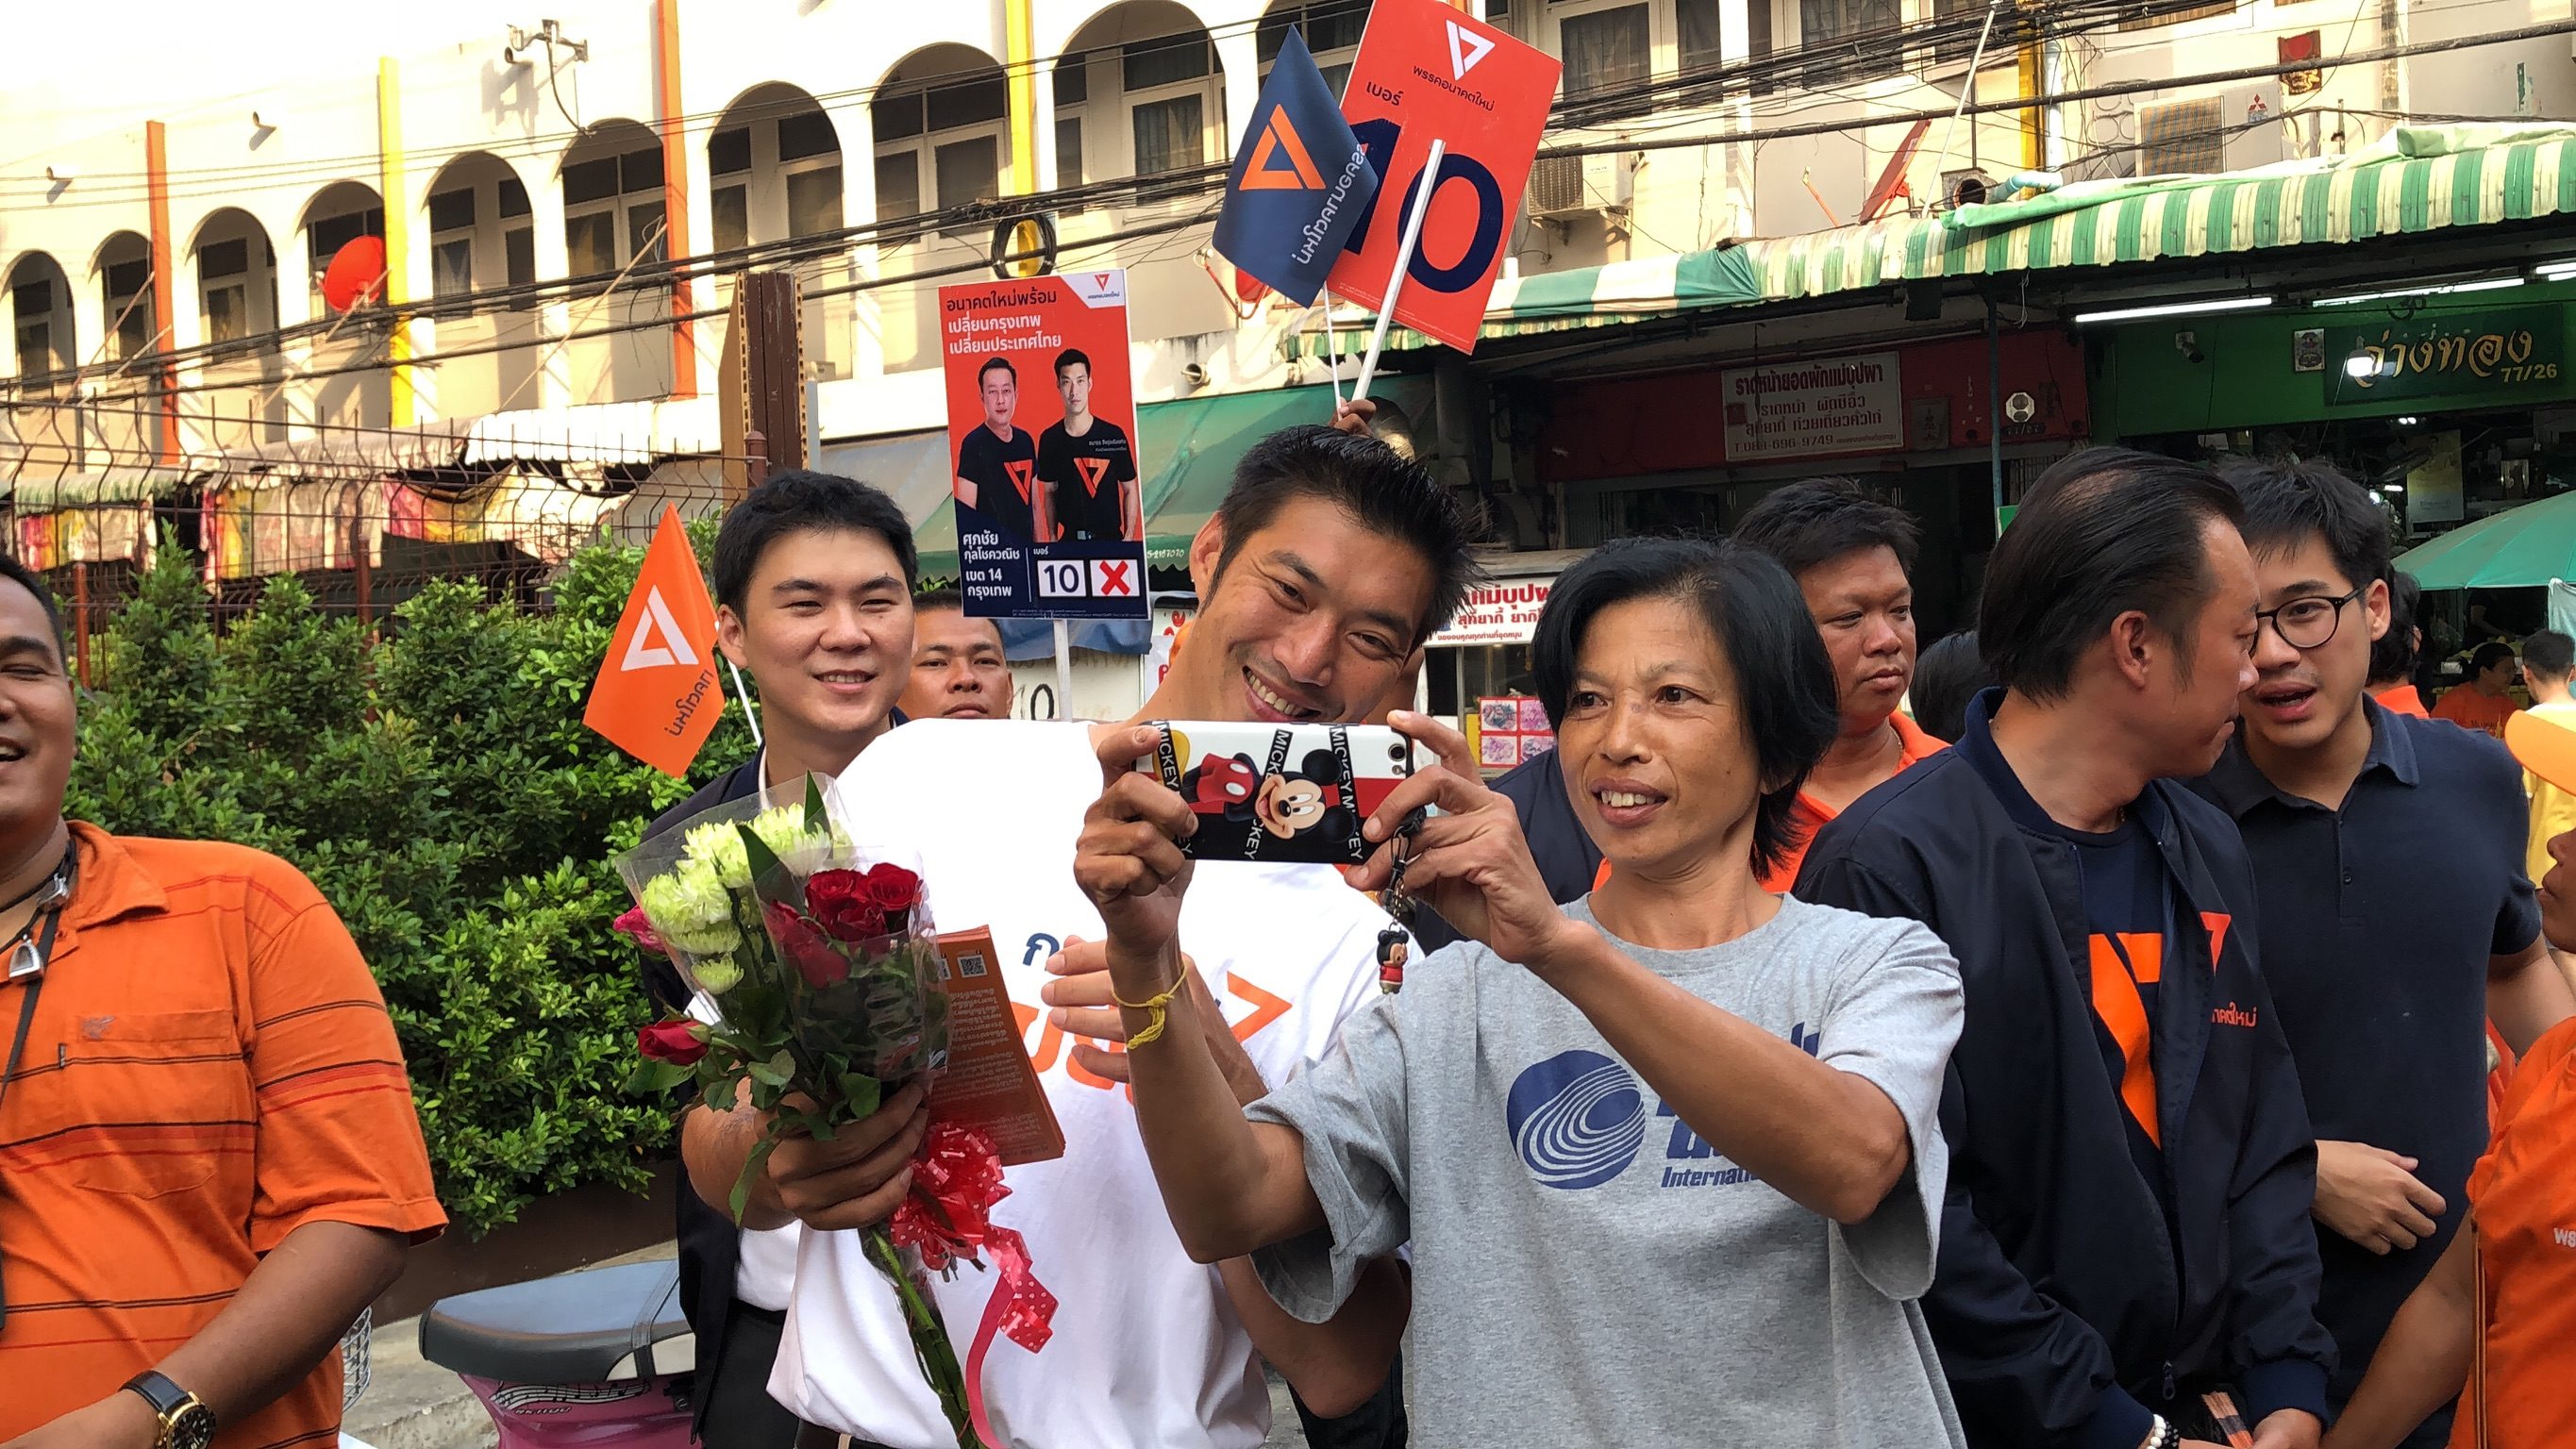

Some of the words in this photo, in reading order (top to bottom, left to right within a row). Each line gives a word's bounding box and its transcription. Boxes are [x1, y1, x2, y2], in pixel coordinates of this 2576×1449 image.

[1365, 81, 1404, 107] เบอร์
[1413, 65, 1495, 111] พรรคอนาคตใหม่
[1345, 118, 1503, 293] 10
[946, 287, 1057, 311] อนาคตใหม่พร้อม
[948, 311, 1041, 334] เปลี่ยนกรุงเทพ
[949, 330, 1062, 355] เปลี่ยนประเทศไทย
[2501, 363, 2557, 383] 77/26
[962, 529, 998, 550] ศุภชัย
[1033, 546, 1048, 555] เบอร์
[963, 546, 1020, 564] กุลโชควณิช
[965, 571, 985, 581] เขต
[988, 567, 1003, 581] 14
[1044, 564, 1079, 593] 10
[967, 586, 1012, 601] กรุงเทพ
